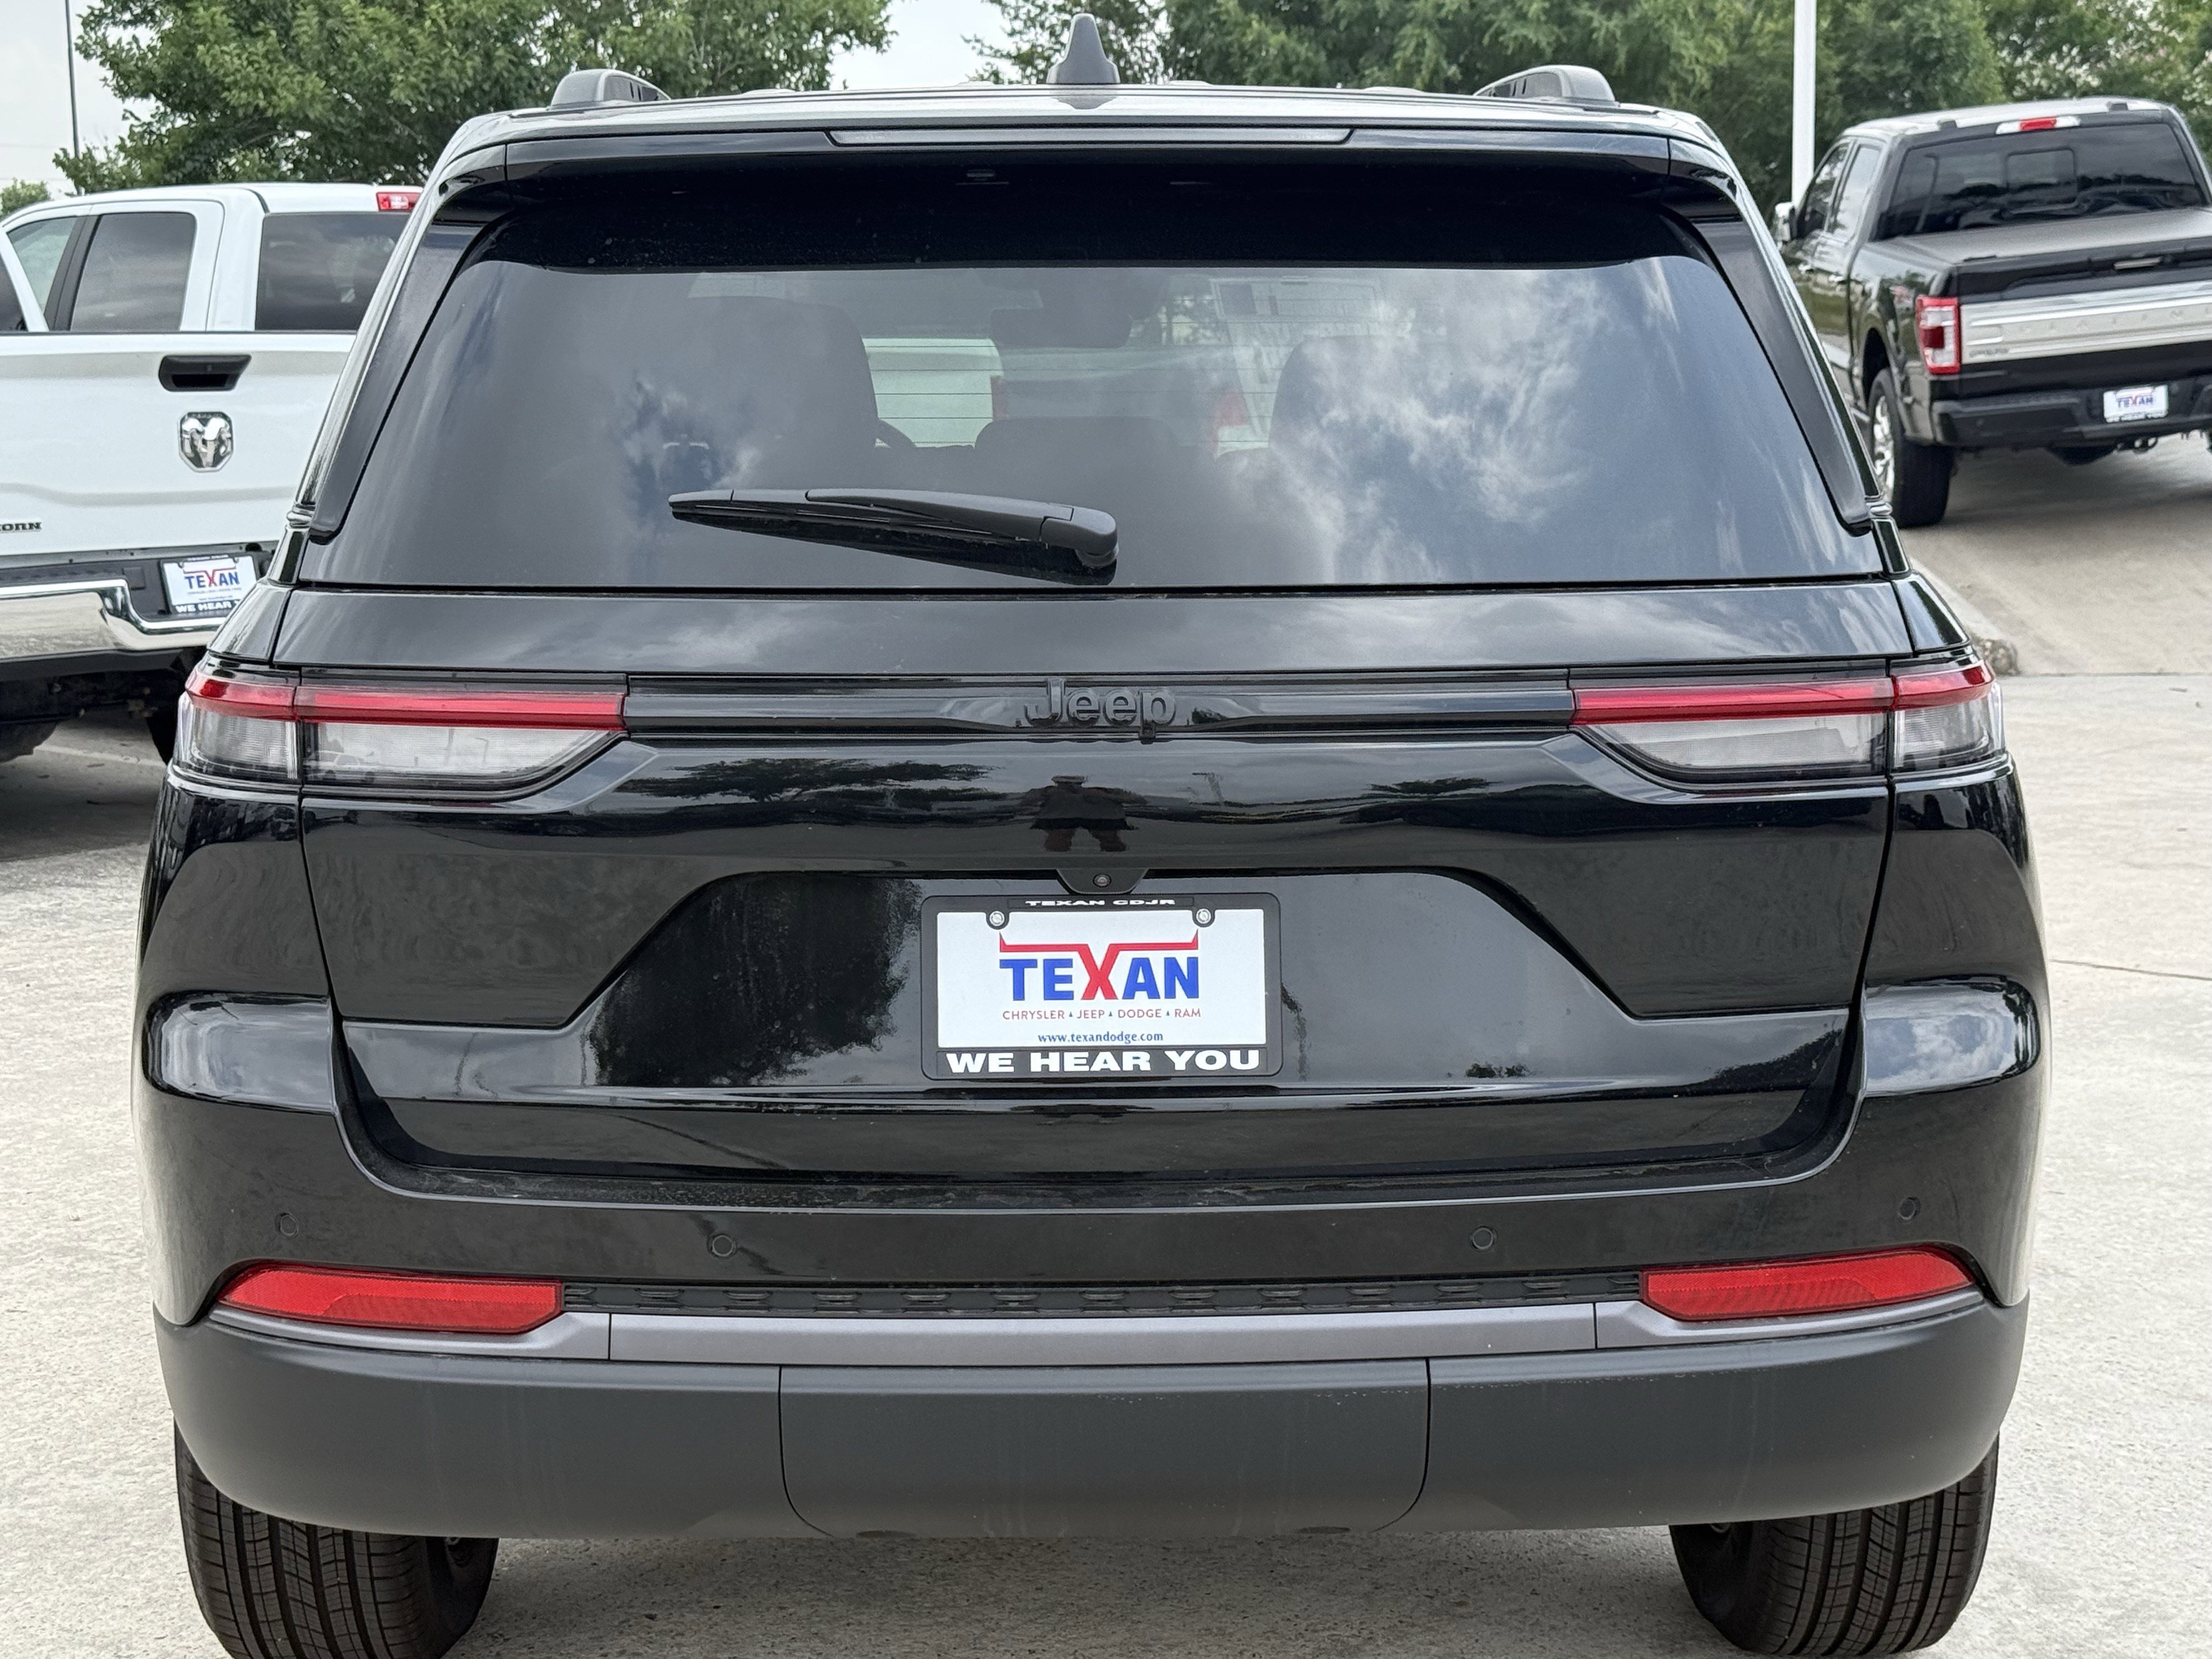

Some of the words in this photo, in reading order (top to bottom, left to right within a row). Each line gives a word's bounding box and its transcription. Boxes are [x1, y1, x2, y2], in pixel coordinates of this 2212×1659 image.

[0, 522, 42, 531] ORN
[184, 569, 240, 589] TEXAN
[176, 605, 196, 613] WE
[1024, 677, 1176, 744] Jeep
[999, 943, 1199, 1002] TEXAN
[1002, 1010, 1065, 1020] CHRYSLER
[1076, 1009, 1105, 1019] JEEP
[1118, 1008, 1162, 1019] DODGE
[1175, 1008, 1201, 1018] RAM
[1037, 1031, 1164, 1044] www.texandodge.com
[945, 1052, 1014, 1074] WE
[1030, 1051, 1152, 1073] HEAR
[1164, 1049, 1260, 1071] YOU
